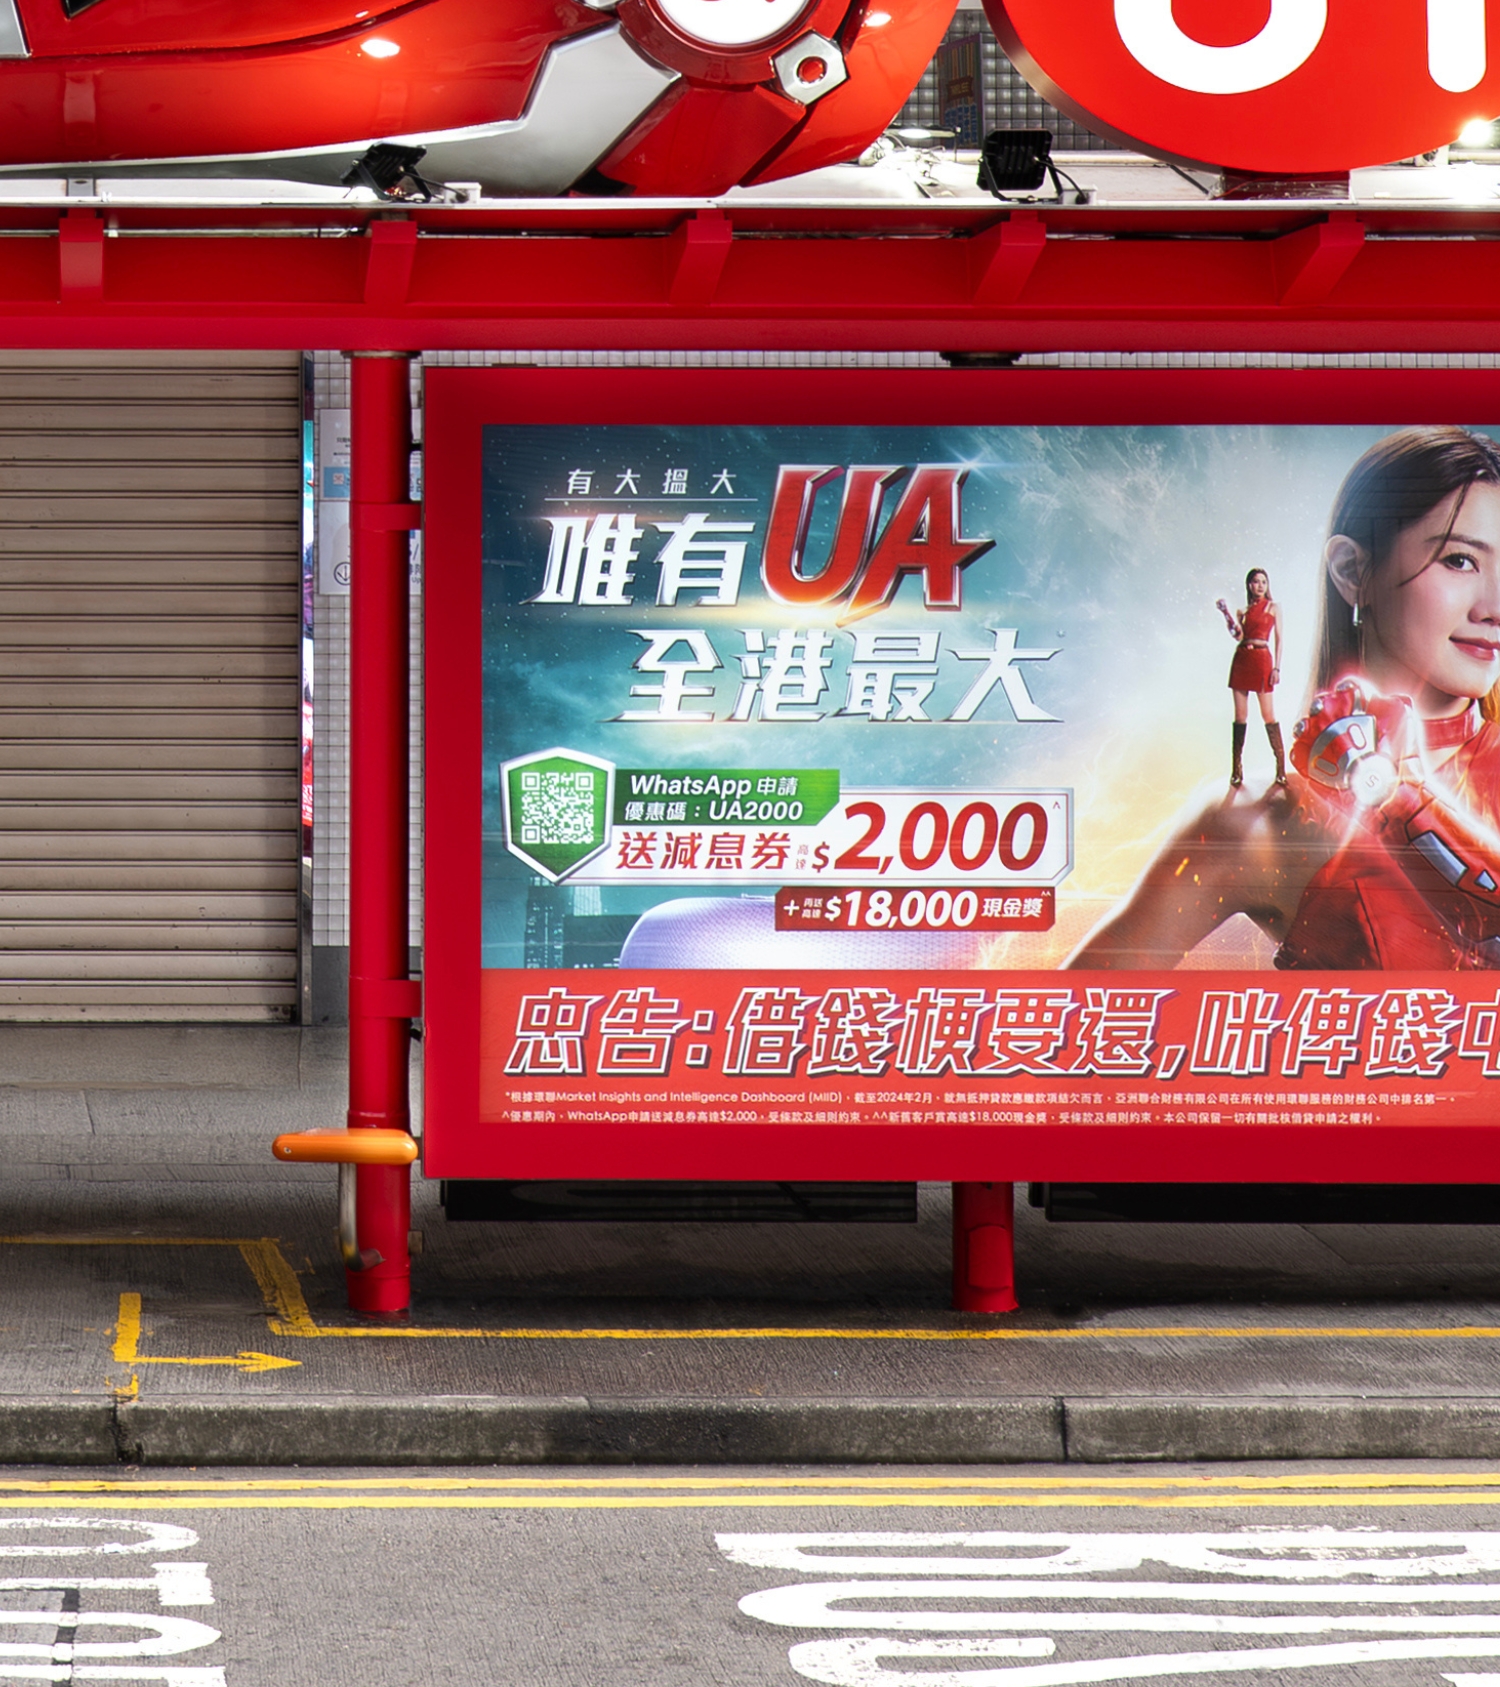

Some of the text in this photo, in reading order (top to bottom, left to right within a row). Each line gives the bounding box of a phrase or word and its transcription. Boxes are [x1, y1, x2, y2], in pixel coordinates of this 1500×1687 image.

[567, 469, 736, 495] 有大搵大
[521, 465, 996, 627] 唯有 UA
[631, 773, 799, 799] WhatsApp 申請
[617, 831, 790, 870] 送減息券
[824, 891, 979, 928] $18,000
[599, 1092, 642, 1104] Insights
[643, 1092, 667, 1102] and
[669, 1092, 738, 1104] Intelligence
[741, 1092, 806, 1103] Dashboard
